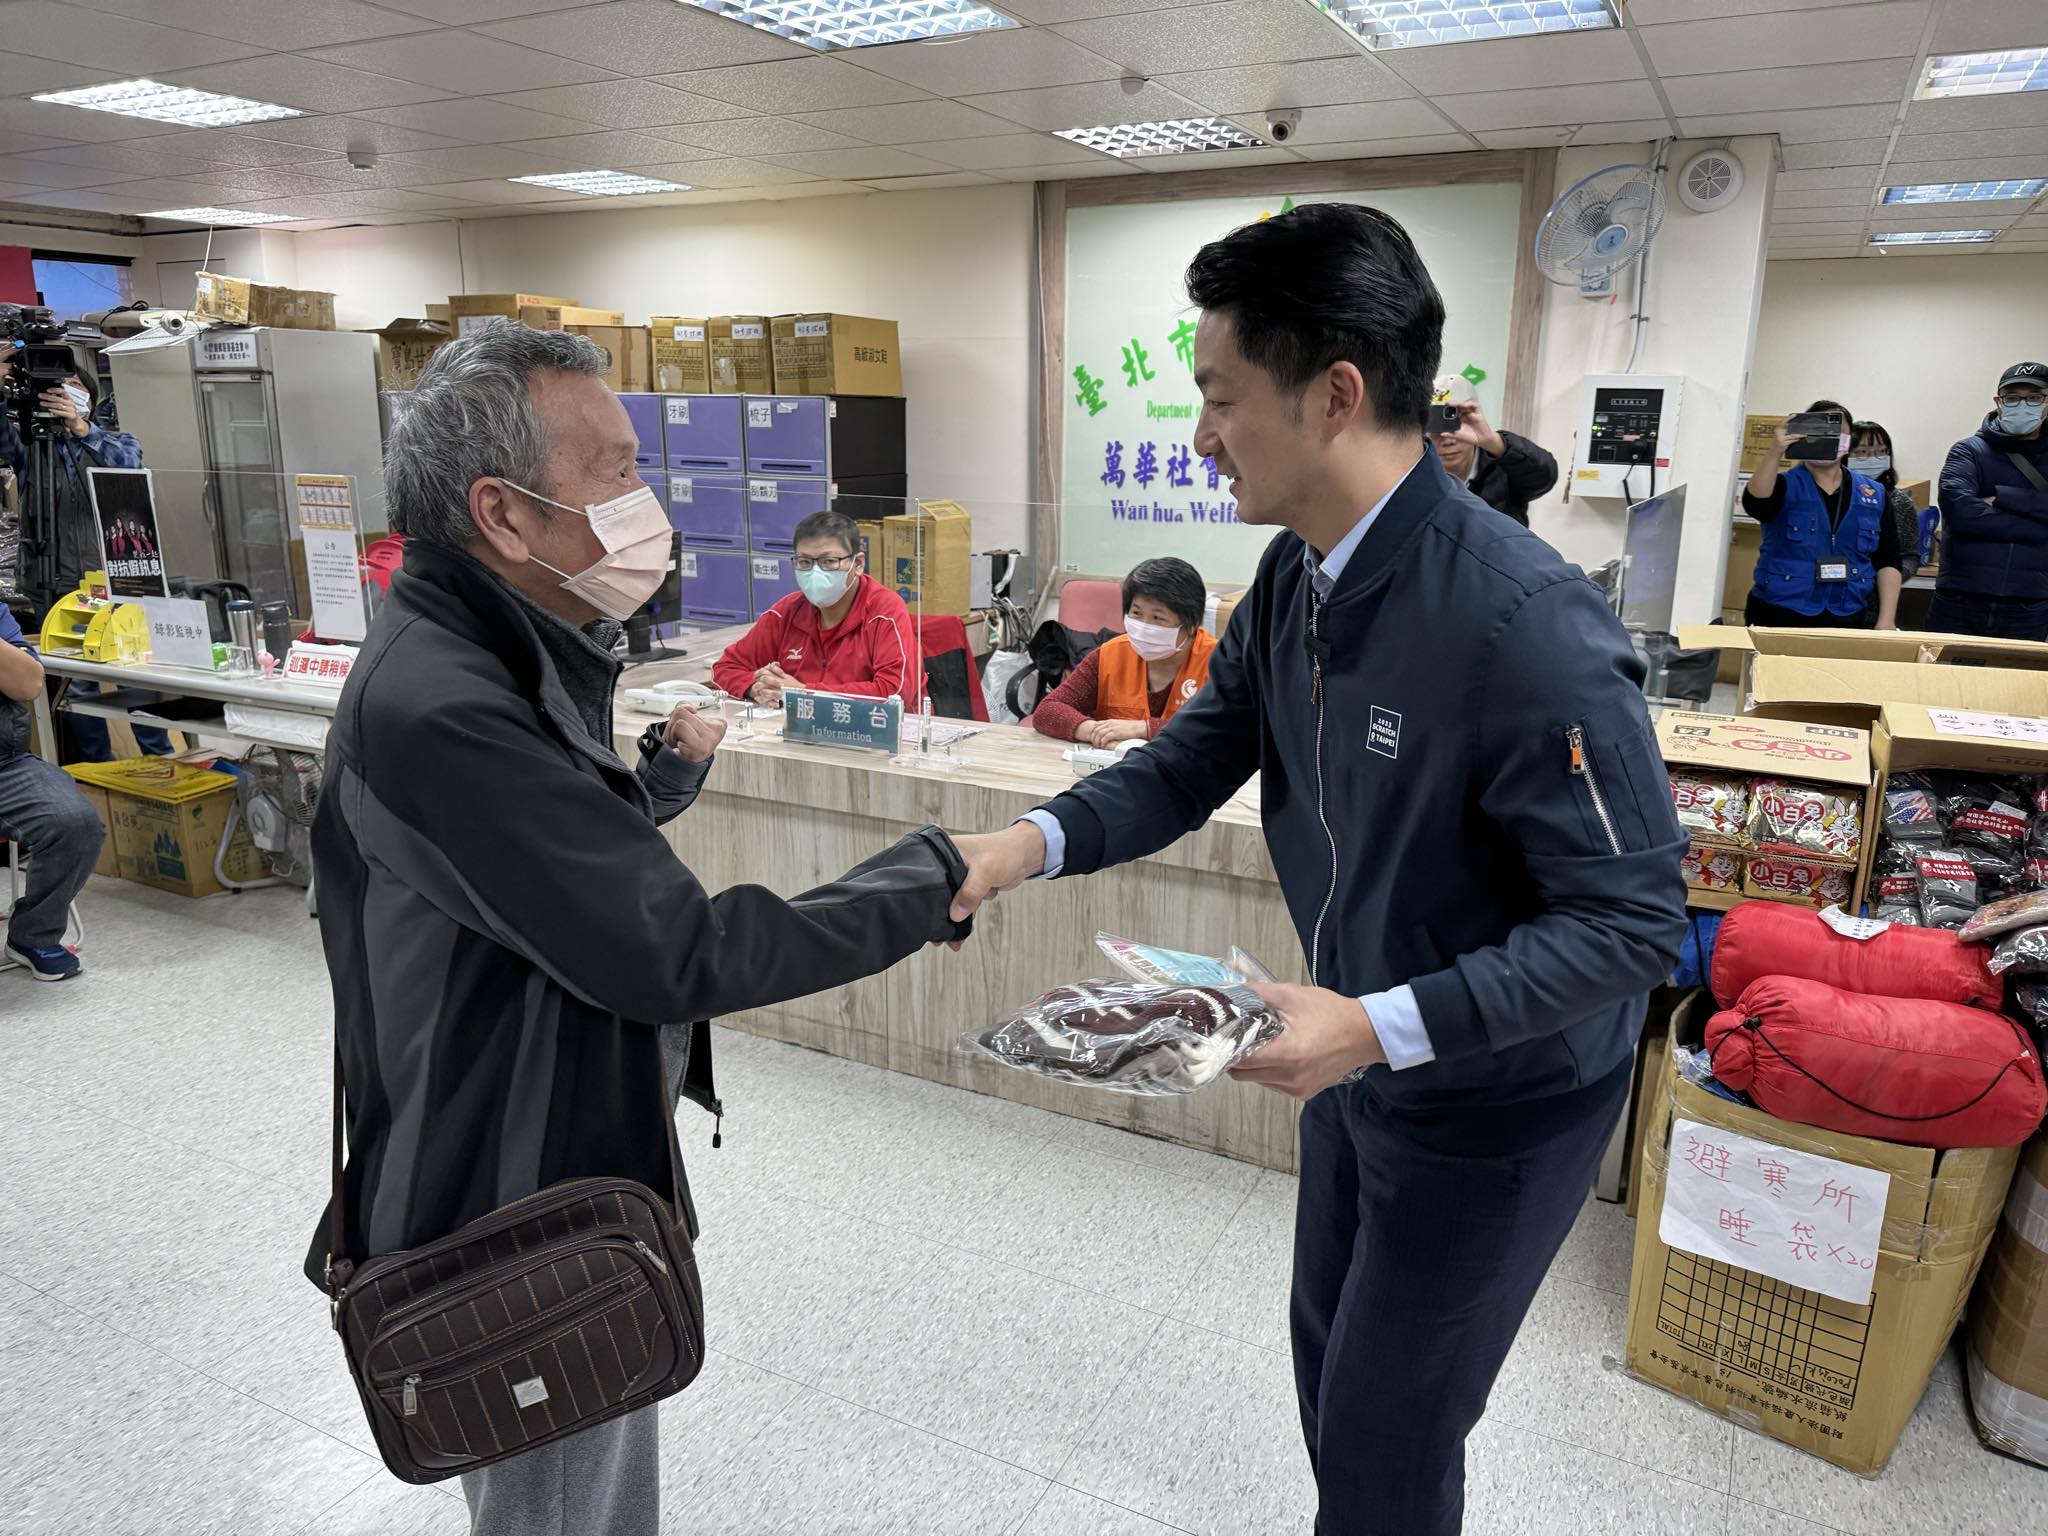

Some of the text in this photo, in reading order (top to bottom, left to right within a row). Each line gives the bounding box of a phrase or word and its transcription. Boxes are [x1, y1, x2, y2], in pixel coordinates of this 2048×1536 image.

[1146, 399, 1193, 422] Department
[1110, 499, 1149, 521] Wan
[1152, 501, 1184, 523] hua
[107, 558, 162, 577] 對抗假訊息
[796, 697, 890, 730] 服務台
[811, 724, 873, 744] Information
[1371, 722, 1397, 738] SCRATCH
[1375, 733, 1396, 748] TAIPEI
[1764, 796, 1822, 821] 小白兔
[1752, 863, 1810, 886] 小白兔
[1684, 1135, 1861, 1224] 避寒所
[1719, 1207, 1818, 1262] 睡袋
[1660, 1320, 1683, 1339] TOTAL
[1700, 1339, 1716, 1352] 2XL
[1737, 1354, 1745, 1365] L
[1749, 1361, 1759, 1371] M
[1763, 1366, 1771, 1376] S
[1774, 1368, 1788, 1380] 女
[1788, 1375, 1801, 1388] 男
[1803, 1380, 1851, 1408] 顏色代號
